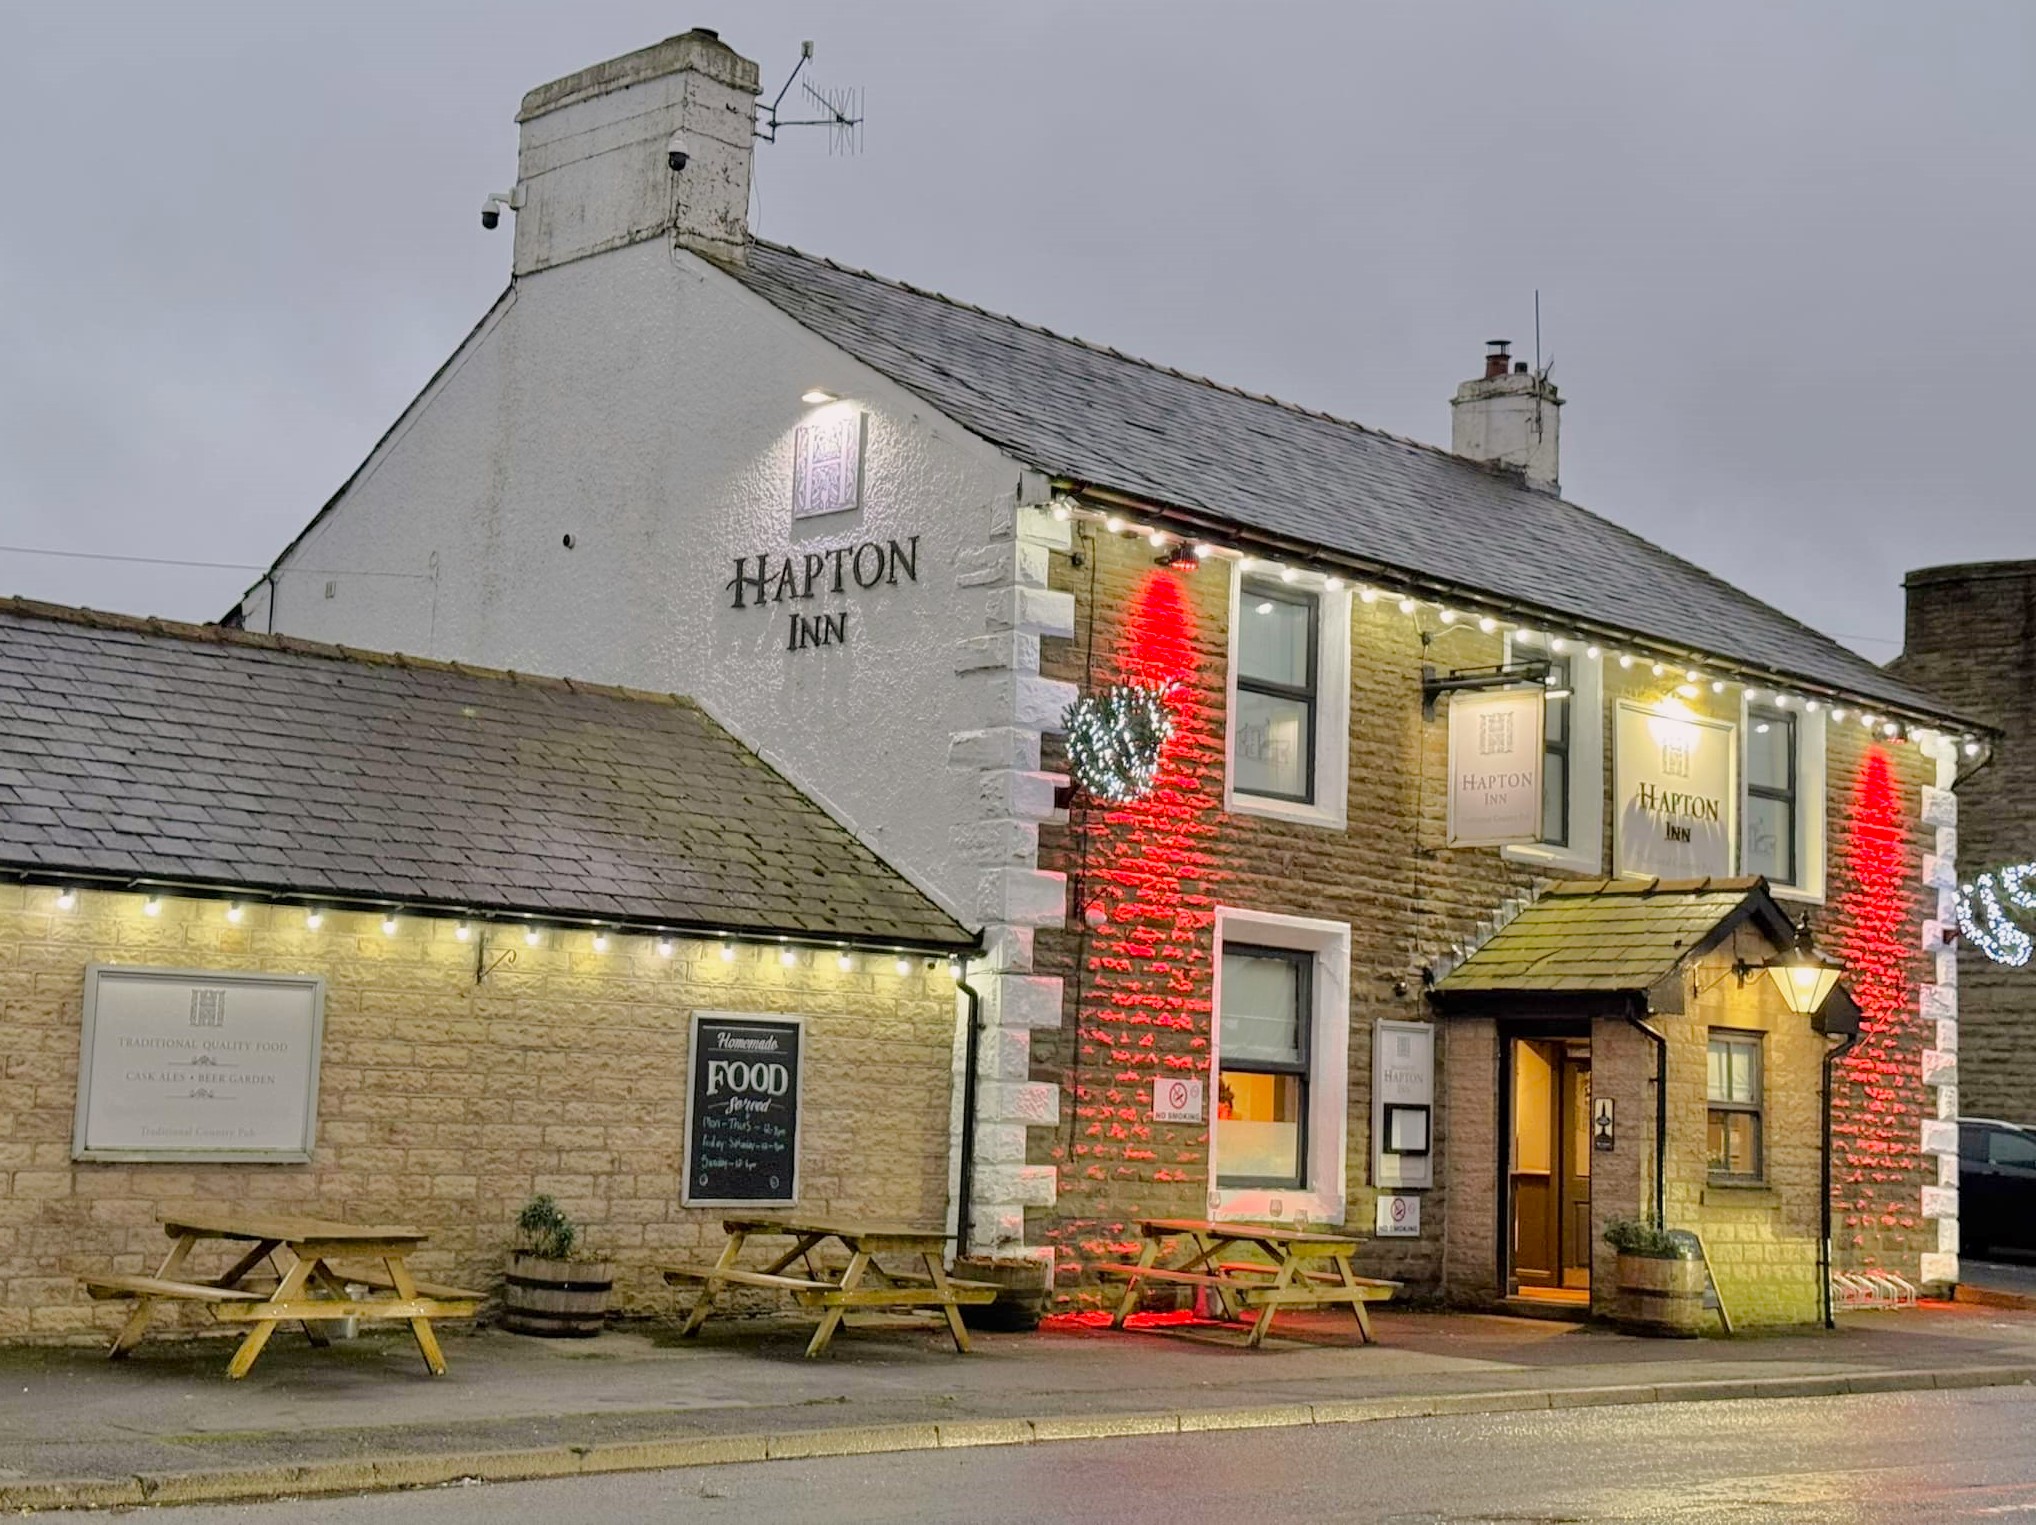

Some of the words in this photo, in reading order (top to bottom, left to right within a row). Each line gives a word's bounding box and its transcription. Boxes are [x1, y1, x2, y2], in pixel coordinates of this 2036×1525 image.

[726, 536, 920, 609] HAPTON
[787, 612, 848, 651] INN
[1460, 772, 1533, 791] HAPTON
[1485, 793, 1507, 806] INN
[1635, 782, 1720, 821] HAPTON
[1664, 821, 1691, 843] INN
[118, 1037, 198, 1050] TRADITIONAL
[202, 1040, 251, 1052] QUALITY
[255, 1041, 288, 1052] FOOD
[717, 1031, 779, 1051] Homemade
[125, 1072, 155, 1082] CASK
[159, 1072, 185, 1082] ALES
[198, 1073, 225, 1083] BEER
[229, 1073, 276, 1084] GARDEN
[706, 1059, 789, 1096] FOOD
[1384, 1069, 1424, 1084] HAPTON
[725, 1096, 772, 1115] Served
[1155, 1111, 1166, 1119] NO
[1168, 1111, 1200, 1121] SMOKING
[1389, 1224, 1418, 1233] SMOKING
